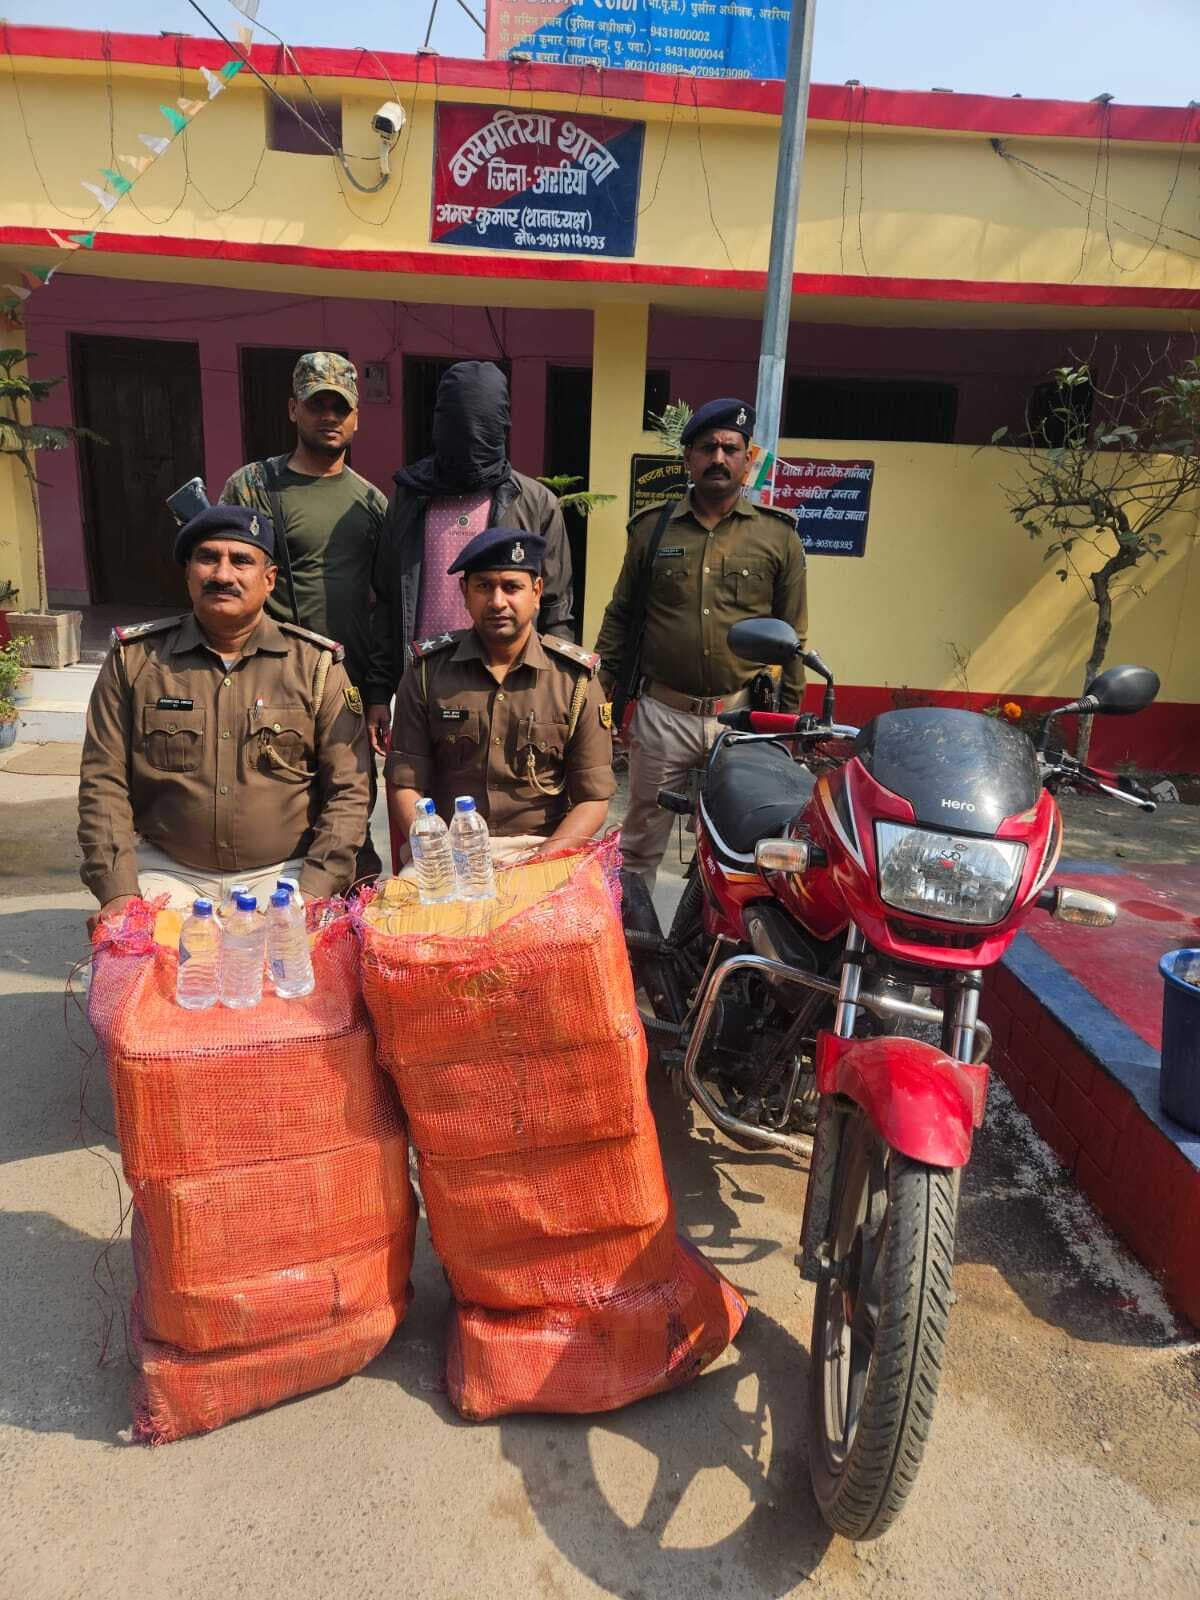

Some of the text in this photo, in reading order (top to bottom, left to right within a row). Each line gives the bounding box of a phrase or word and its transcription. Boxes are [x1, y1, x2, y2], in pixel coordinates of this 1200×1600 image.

[448, 110, 620, 187] बसमतिया थाना
[436, 203, 475, 225] अमर
[475, 207, 520, 234] कुमार
[941, 798, 976, 813] Hero
